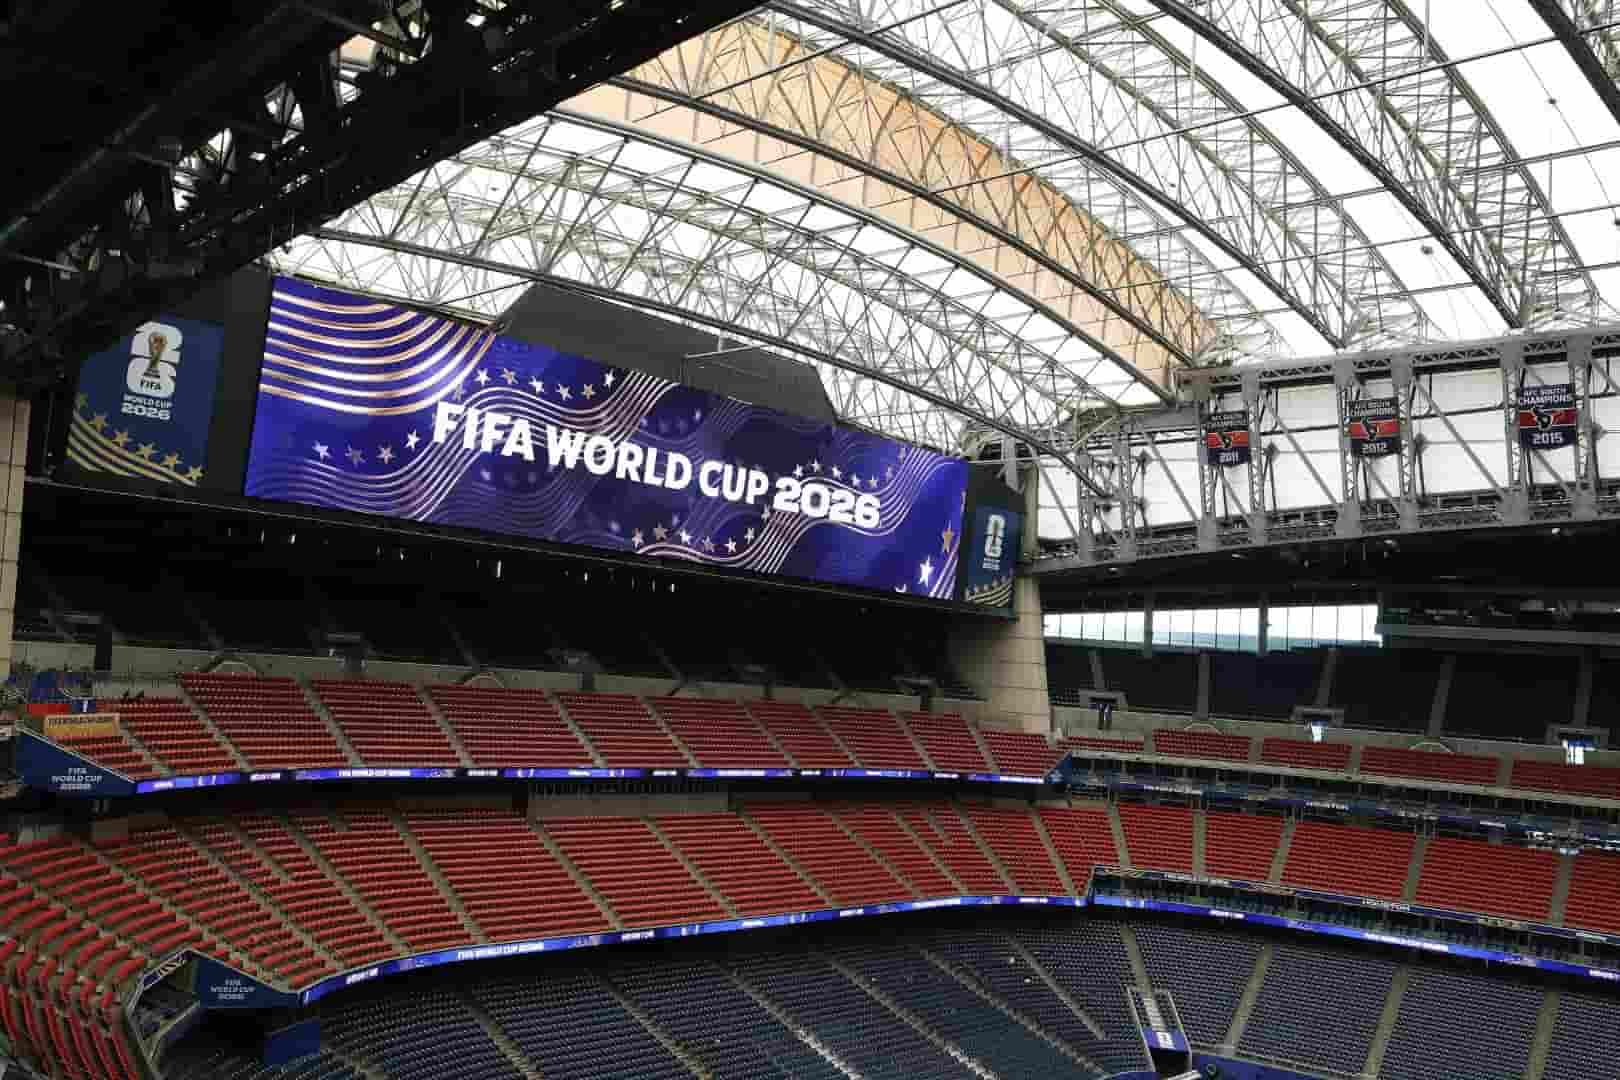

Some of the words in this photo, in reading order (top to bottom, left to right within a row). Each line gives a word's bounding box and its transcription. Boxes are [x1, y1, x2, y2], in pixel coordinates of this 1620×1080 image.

[121, 402, 171, 420] 2026
[1531, 432, 1564, 446] 2015
[1361, 442, 1388, 455] 2012
[432, 400, 536, 462] FIFA
[545, 423, 692, 490] WORLD
[699, 459, 769, 505] CUP
[772, 475, 881, 529] 2026
